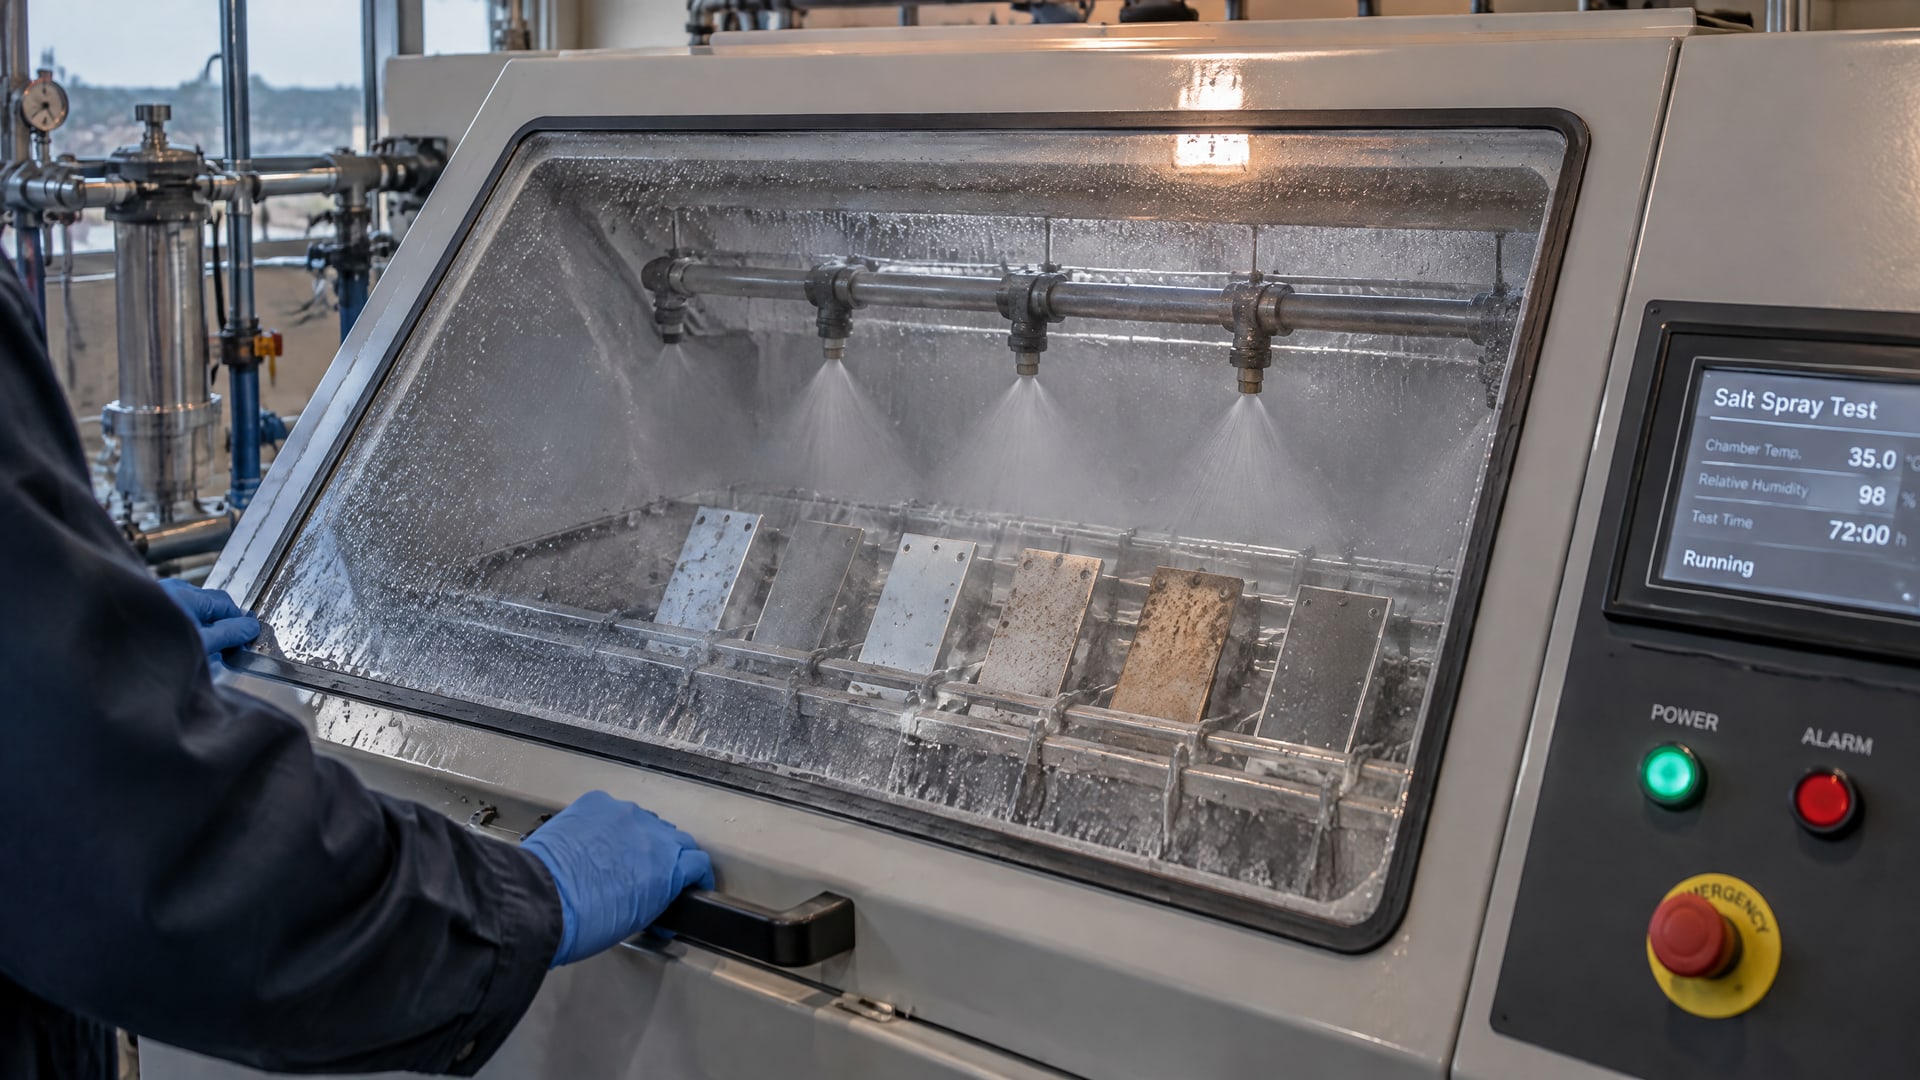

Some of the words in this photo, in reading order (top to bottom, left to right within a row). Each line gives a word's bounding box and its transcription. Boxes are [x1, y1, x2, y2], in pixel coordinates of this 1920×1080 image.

[1714, 387, 1756, 409] Salt
[1761, 391, 1824, 419] Spray
[1830, 396, 1878, 420] Test
[1705, 438, 1760, 456] Chamber
[1764, 443, 1802, 461] Temp.
[1847, 446, 1897, 470] 35.0
[1698, 472, 1749, 490] Relative
[1752, 478, 1810, 498] Humidity
[1858, 485, 1886, 506] 98
[1692, 510, 1718, 525] Test
[1722, 513, 1754, 530] Time
[1829, 520, 1891, 546] 72:00
[1682, 549, 1755, 578] Running
[1651, 704, 1720, 732] POWER
[1801, 727, 1874, 757] ALARM
